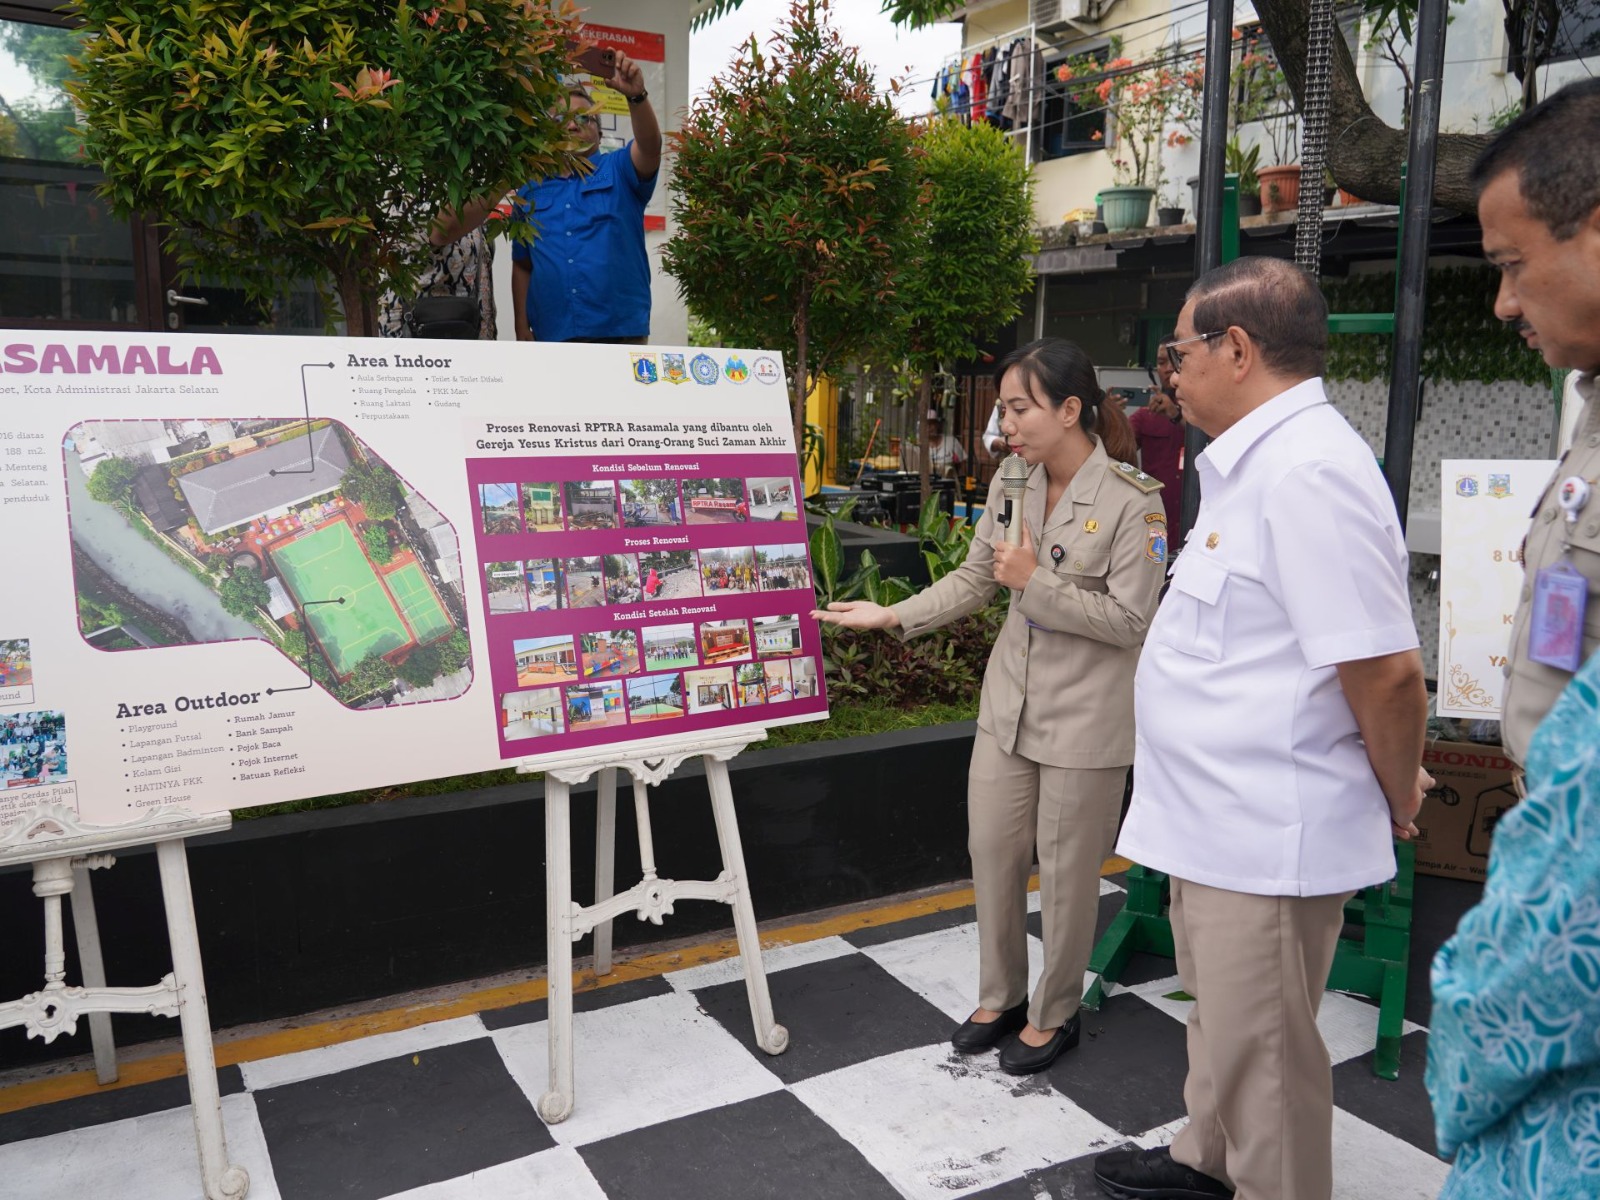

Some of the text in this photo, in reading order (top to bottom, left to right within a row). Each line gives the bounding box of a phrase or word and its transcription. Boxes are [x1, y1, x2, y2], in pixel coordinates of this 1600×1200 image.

[579, 29, 635, 43] EKERASAN
[0, 343, 223, 375] SAMALA
[347, 353, 452, 368] Area Indoor
[357, 374, 374, 382] Aula
[24, 384, 52, 394] Kota
[56, 384, 131, 394] Administrasi
[135, 384, 176, 394] Jakarta
[180, 384, 219, 394] Selatan
[358, 387, 382, 395] Ruang
[360, 400, 384, 408] Ruang
[434, 400, 460, 408] Gudang
[361, 412, 410, 420] Perpustakaan
[486, 422, 773, 434] Proses Renovasi RPTRA Rasamala yang dibantu oleh
[16, 431, 45, 439] diatas
[476, 437, 787, 452] Gereja Yesus Kristus dari Orang-Orang Suci Zaman Akhir
[4, 447, 22, 456] 188
[5, 463, 48, 472] Menteng
[592, 462, 700, 473] Kondisi Sebelum Renovasi
[11, 478, 48, 487] Selatan.
[4, 494, 50, 505] penduduk
[624, 535, 690, 547] Proses Renovasi
[1493, 550, 1502, 562] 8
[613, 604, 717, 622] Kondisi Setelah Renovasi
[116, 692, 261, 719] Area Outdoor
[234, 711, 296, 724] Rumah Jamur
[128, 720, 178, 734] Playground
[235, 724, 294, 738] Bank Sampah
[130, 732, 202, 748] Lapangan Futsal
[237, 743, 260, 752] Pojok
[130, 745, 225, 764] Lapangan Badminton
[238, 753, 298, 766] Pojok Internet
[1422, 750, 1514, 771] HOND
[132, 768, 162, 778] Kolam
[240, 766, 306, 781] Batuan Refleksi
[134, 776, 204, 793] HATINYA PKK
[22, 790, 50, 800] Cerdas
[52, 786, 74, 796] Pilah
[20, 800, 37, 808] oleh
[135, 794, 192, 808] Green House
